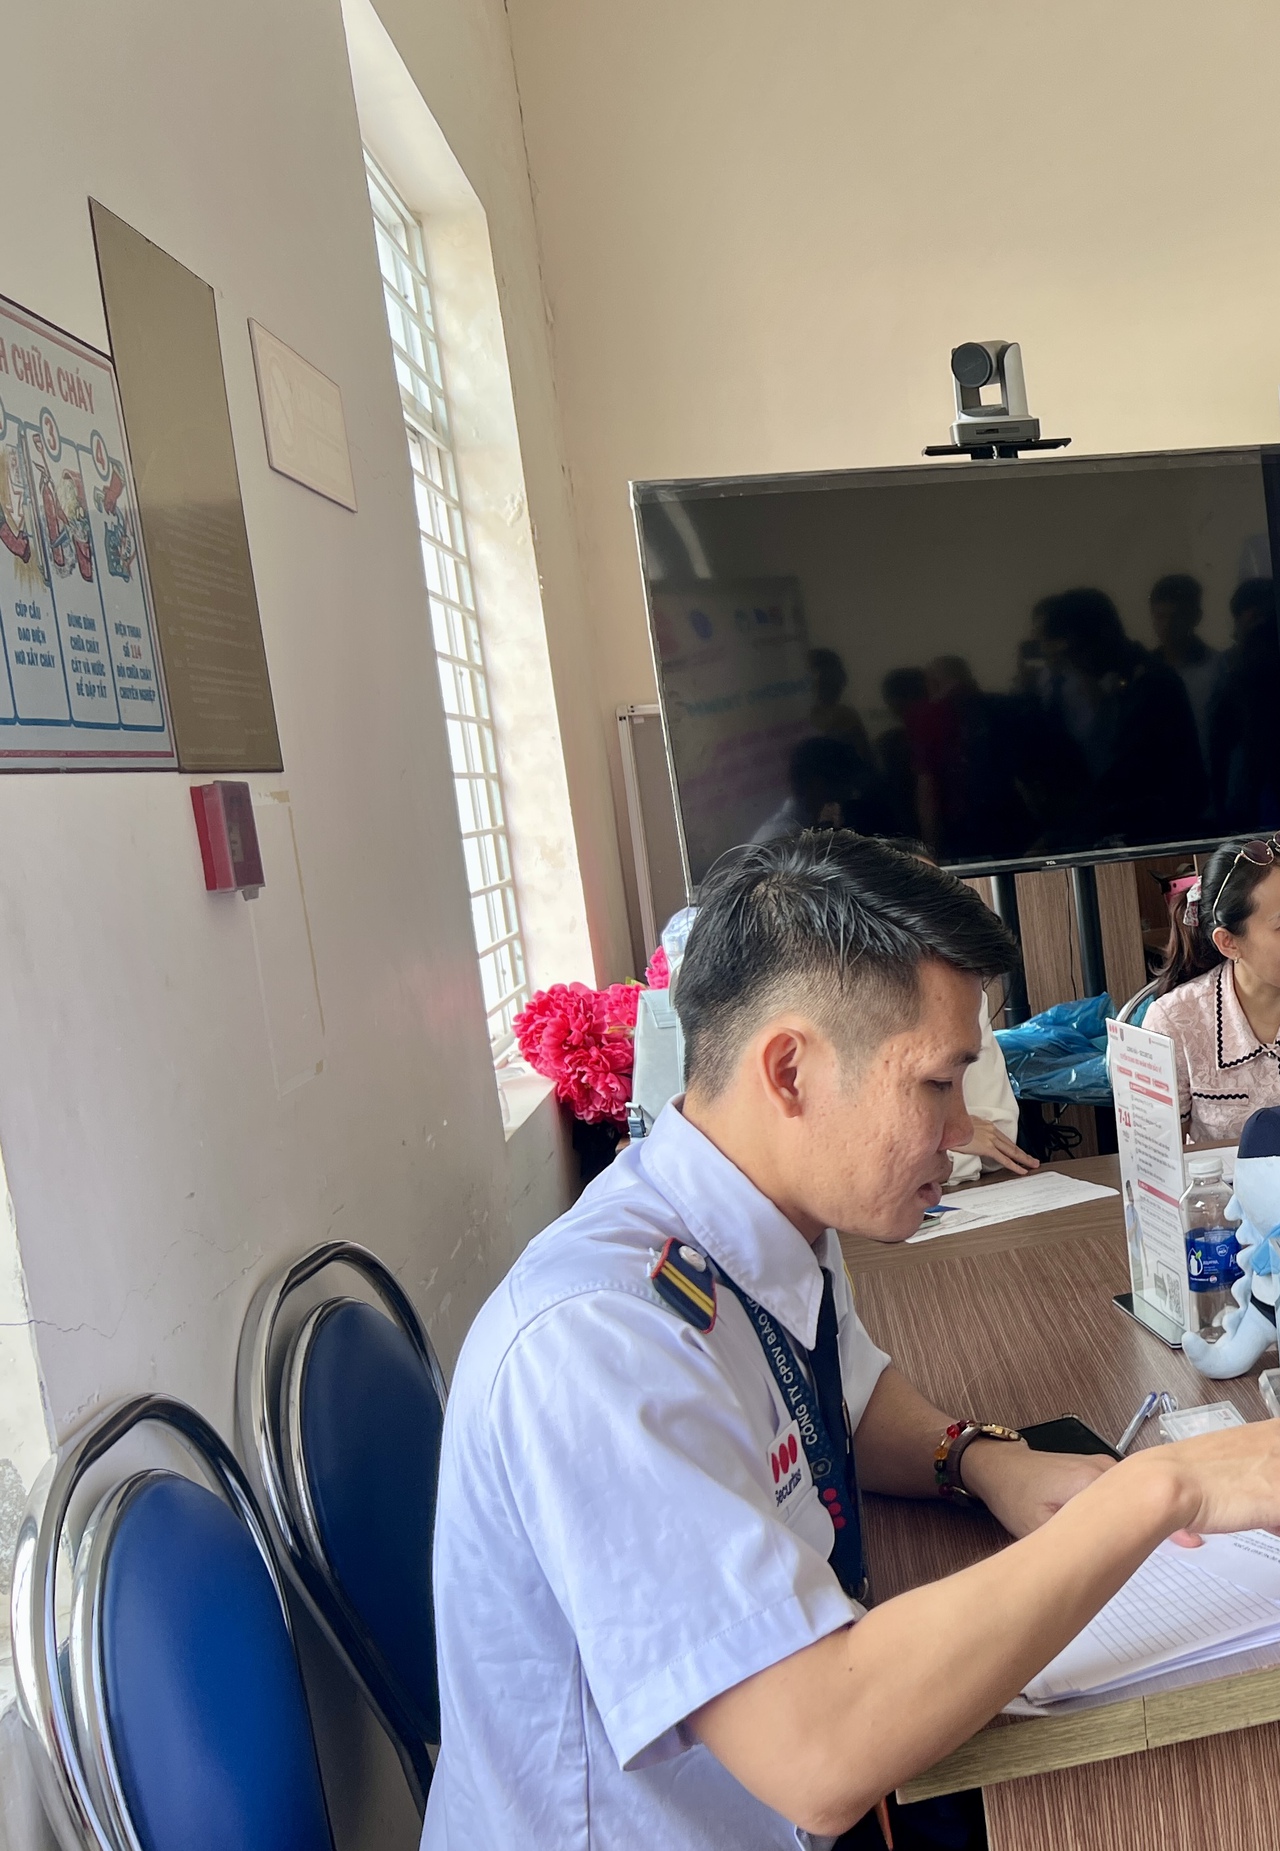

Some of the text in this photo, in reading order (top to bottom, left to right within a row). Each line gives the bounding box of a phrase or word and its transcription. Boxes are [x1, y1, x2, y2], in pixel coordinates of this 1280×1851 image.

[11, 343, 56, 397] CHỮA
[57, 367, 94, 414] CHÁY
[772, 1346, 794, 1384] CPDV
[787, 1385, 802, 1406] TY
[794, 1404, 818, 1446] CÔNG
